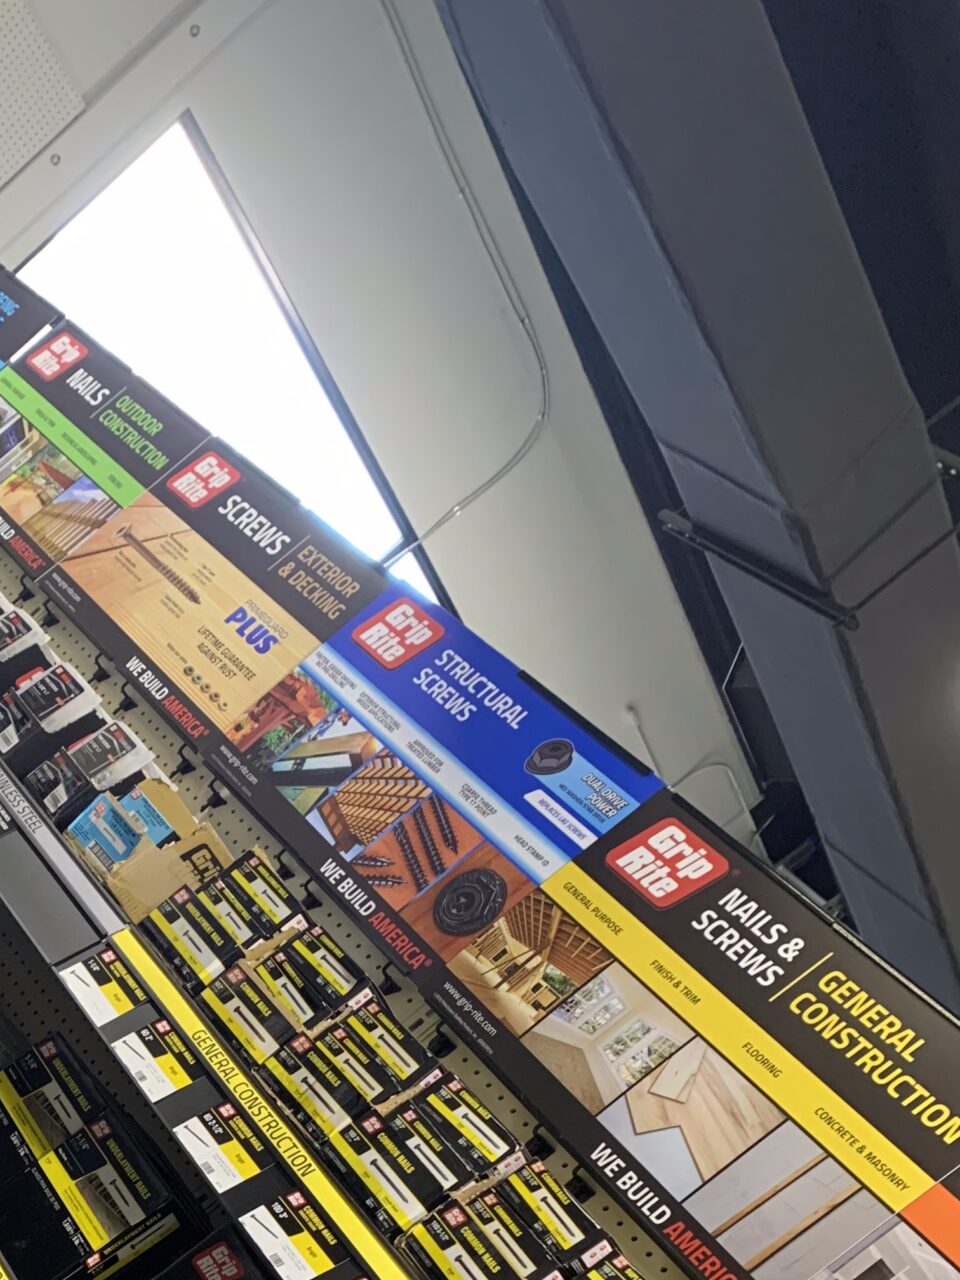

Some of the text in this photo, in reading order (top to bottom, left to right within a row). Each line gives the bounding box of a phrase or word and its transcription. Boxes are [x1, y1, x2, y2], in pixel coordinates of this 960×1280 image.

[66, 368, 111, 407] NAILS
[98, 408, 169, 471] CONSTRUCTION
[115, 394, 164, 437] OUTDOOR
[172, 472, 209, 504] Rite
[194, 455, 231, 491] Grip
[217, 494, 291, 556] SCREWS
[278, 562, 347, 622] & DECKING
[296, 544, 360, 598] EXTERIOR
[224, 606, 279, 655] PLUS
[245, 598, 289, 639] PRIMEGUARD
[358, 622, 406, 662] Rite
[384, 603, 433, 648] Grip
[125, 655, 142, 674] WE
[139, 670, 169, 701] BUILD
[196, 642, 238, 680] AGAINST RUST
[198, 625, 257, 682] LIFETIME GUARANTEE
[412, 667, 478, 723] SCREWS
[434, 648, 529, 730] STRUCTURAL
[461, 782, 498, 816] COARSE THREAD
[581, 772, 631, 812] DUAL DRIVE
[585, 793, 618, 819] POWER
[16, 803, 44, 834] STEEL
[538, 798, 587, 841] REPLACES LAG SCREWS
[513, 834, 550, 867] HEAD STAMP ID
[614, 844, 681, 903] Rite
[650, 824, 716, 882] Grip
[319, 857, 349, 887] WE
[340, 880, 376, 917] BUILD
[562, 881, 624, 937] GENERAL PURPOSE
[690, 910, 787, 989] SCREWS
[717, 887, 805, 963] NAILS &
[442, 980, 498, 1038] www.grip-rite.com
[649, 959, 702, 1007] FINISH & TRIM
[817, 969, 929, 1063] GENERAL
[741, 1042, 783, 1080] FLOORING
[788, 992, 960, 1146] CONSTRUCTION
[188, 1026, 317, 1180] GENERAL CONSTRUCTION
[104, 1136, 152, 1200] UNDERLAYMENT NAILS
[814, 1106, 911, 1193] CONCRETE & MASONRY
[590, 1142, 627, 1179] WE
[616, 1168, 672, 1226] BUILD
[209, 1243, 241, 1278] Grip
[458, 1224, 502, 1275] COMMON NAILS
